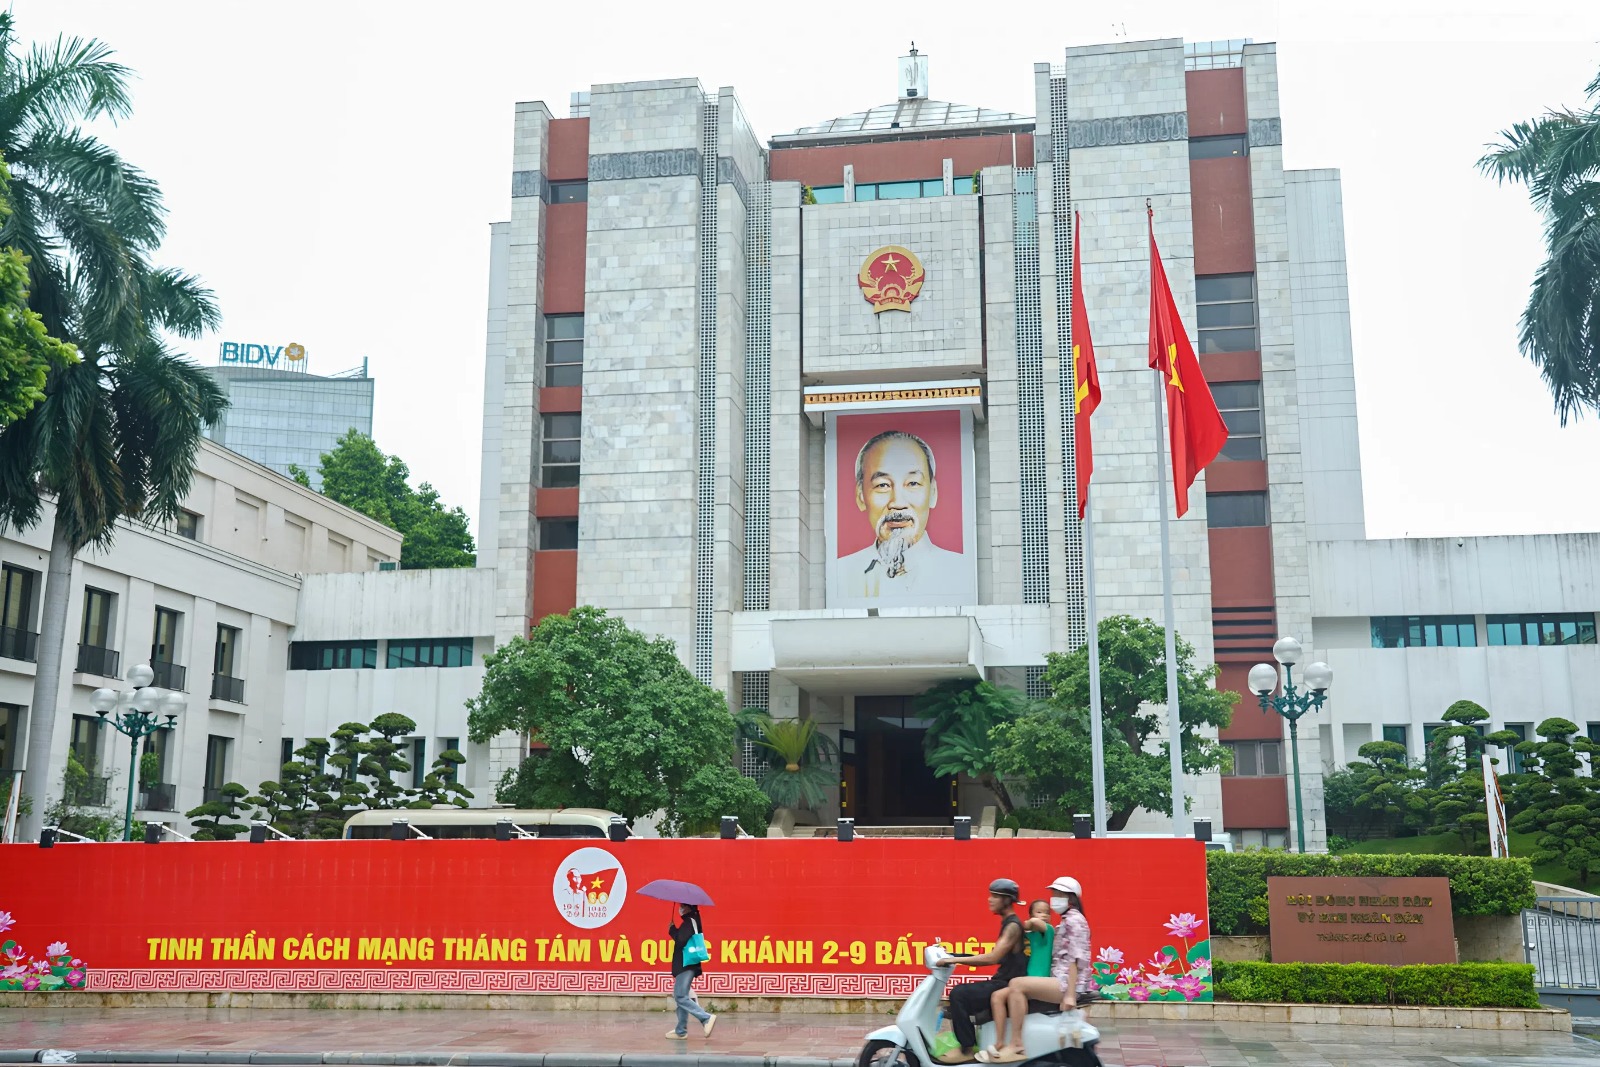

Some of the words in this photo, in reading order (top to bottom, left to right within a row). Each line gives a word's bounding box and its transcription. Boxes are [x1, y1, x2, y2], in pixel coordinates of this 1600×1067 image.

[222, 342, 284, 365] BIDV
[147, 938, 203, 960] TINH
[211, 930, 275, 960] THẦN
[283, 933, 350, 960] CÁCH
[358, 938, 434, 965] MẠNG
[442, 934, 526, 961] THÁNG
[535, 934, 590, 962] TÁM
[599, 936, 632, 962] VÀ
[641, 939, 711, 965] QU
[721, 936, 813, 963] KHÁNH
[822, 941, 866, 964] 2-9
[876, 933, 927, 965] BẤT
